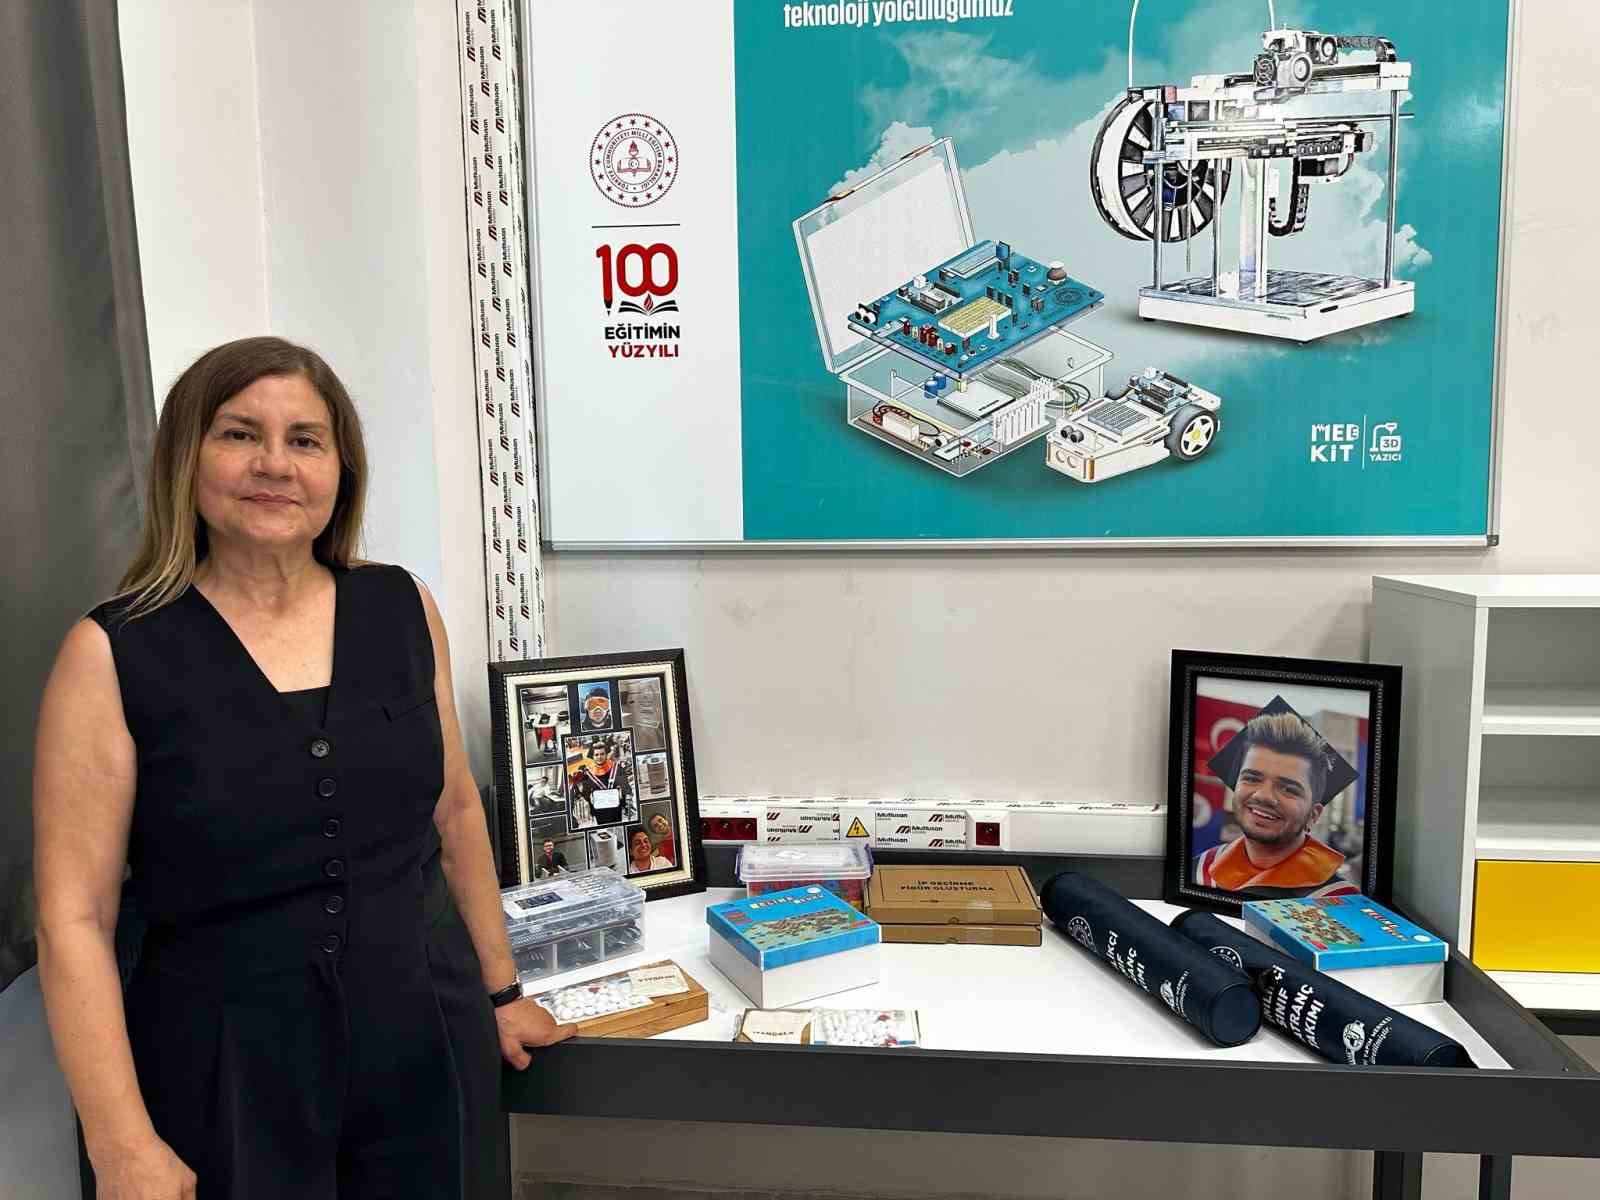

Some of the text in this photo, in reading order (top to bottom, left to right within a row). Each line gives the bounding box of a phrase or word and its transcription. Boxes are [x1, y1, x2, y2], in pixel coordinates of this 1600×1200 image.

[784, 0, 869, 27] teknoloji
[596, 243, 678, 308] 100
[604, 323, 680, 339] EĞİTİMİN
[608, 342, 679, 358] YÜZYILI
[1311, 424, 1360, 442] MEB
[1382, 438, 1399, 449] 3D
[1369, 453, 1402, 462] YAZICI
